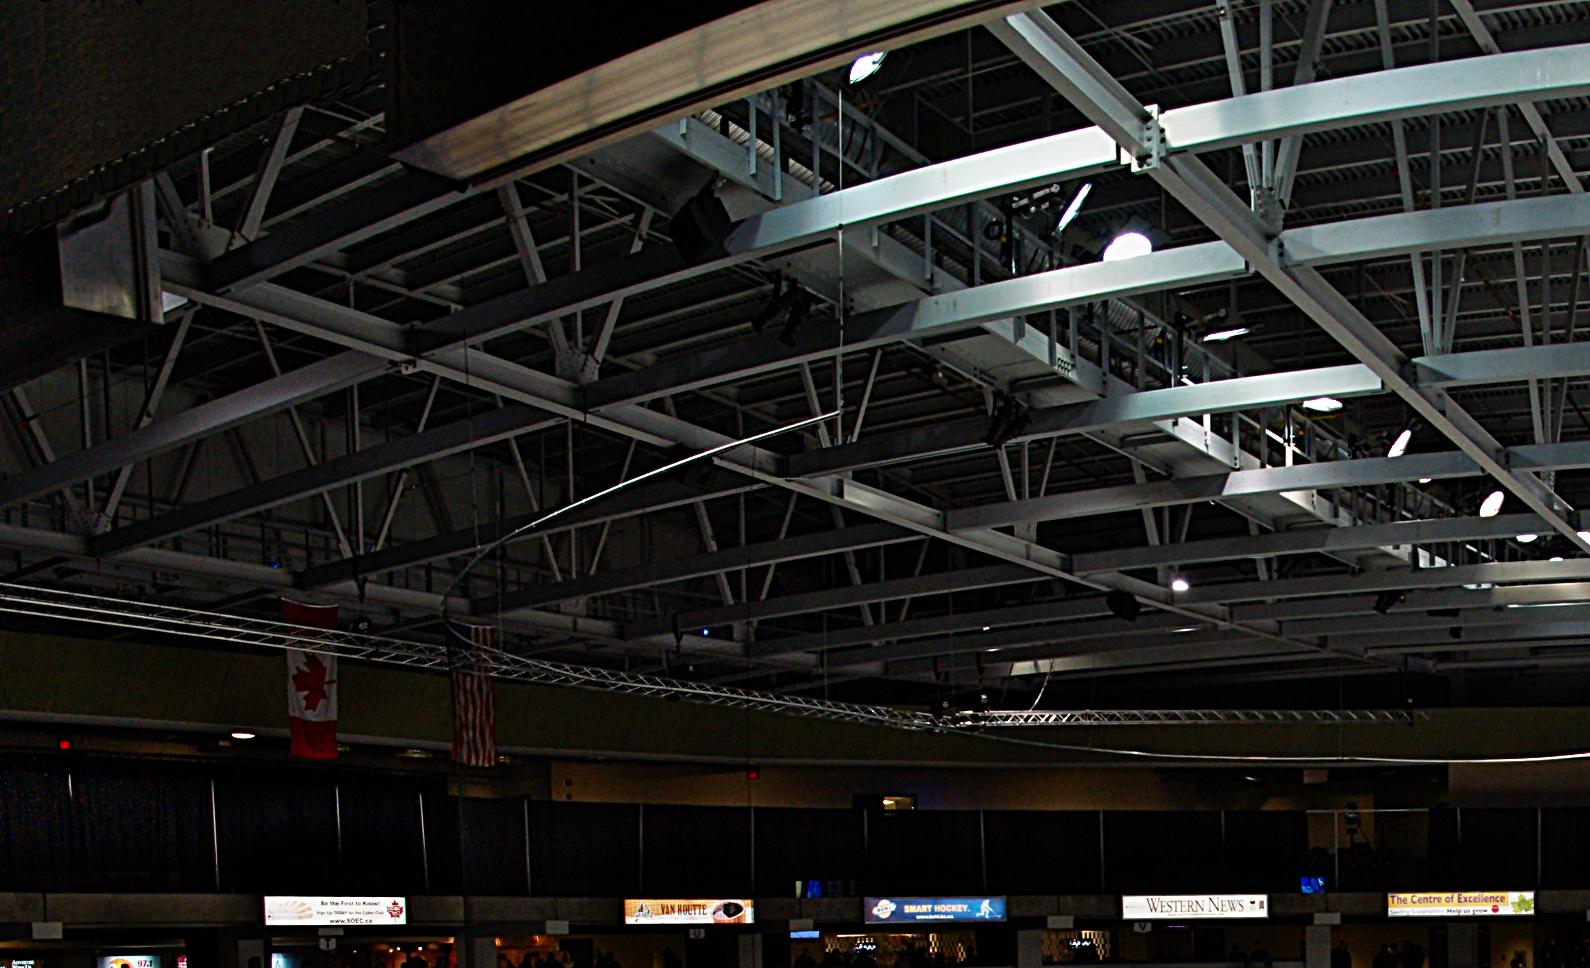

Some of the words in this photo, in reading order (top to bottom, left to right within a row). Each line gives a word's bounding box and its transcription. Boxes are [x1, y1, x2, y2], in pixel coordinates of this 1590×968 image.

[1146, 898, 1205, 913] WESTERN
[1208, 897, 1245, 913] NEWS
[1390, 895, 1408, 905] The
[1410, 895, 1442, 905] Centre
[1444, 894, 1454, 904] of
[1457, 893, 1506, 903] Excellence
[660, 903, 676, 915] VAN
[677, 903, 707, 916] HOUTTE
[1446, 908, 1462, 916] Help
[137, 959, 153, 968] 97.1
